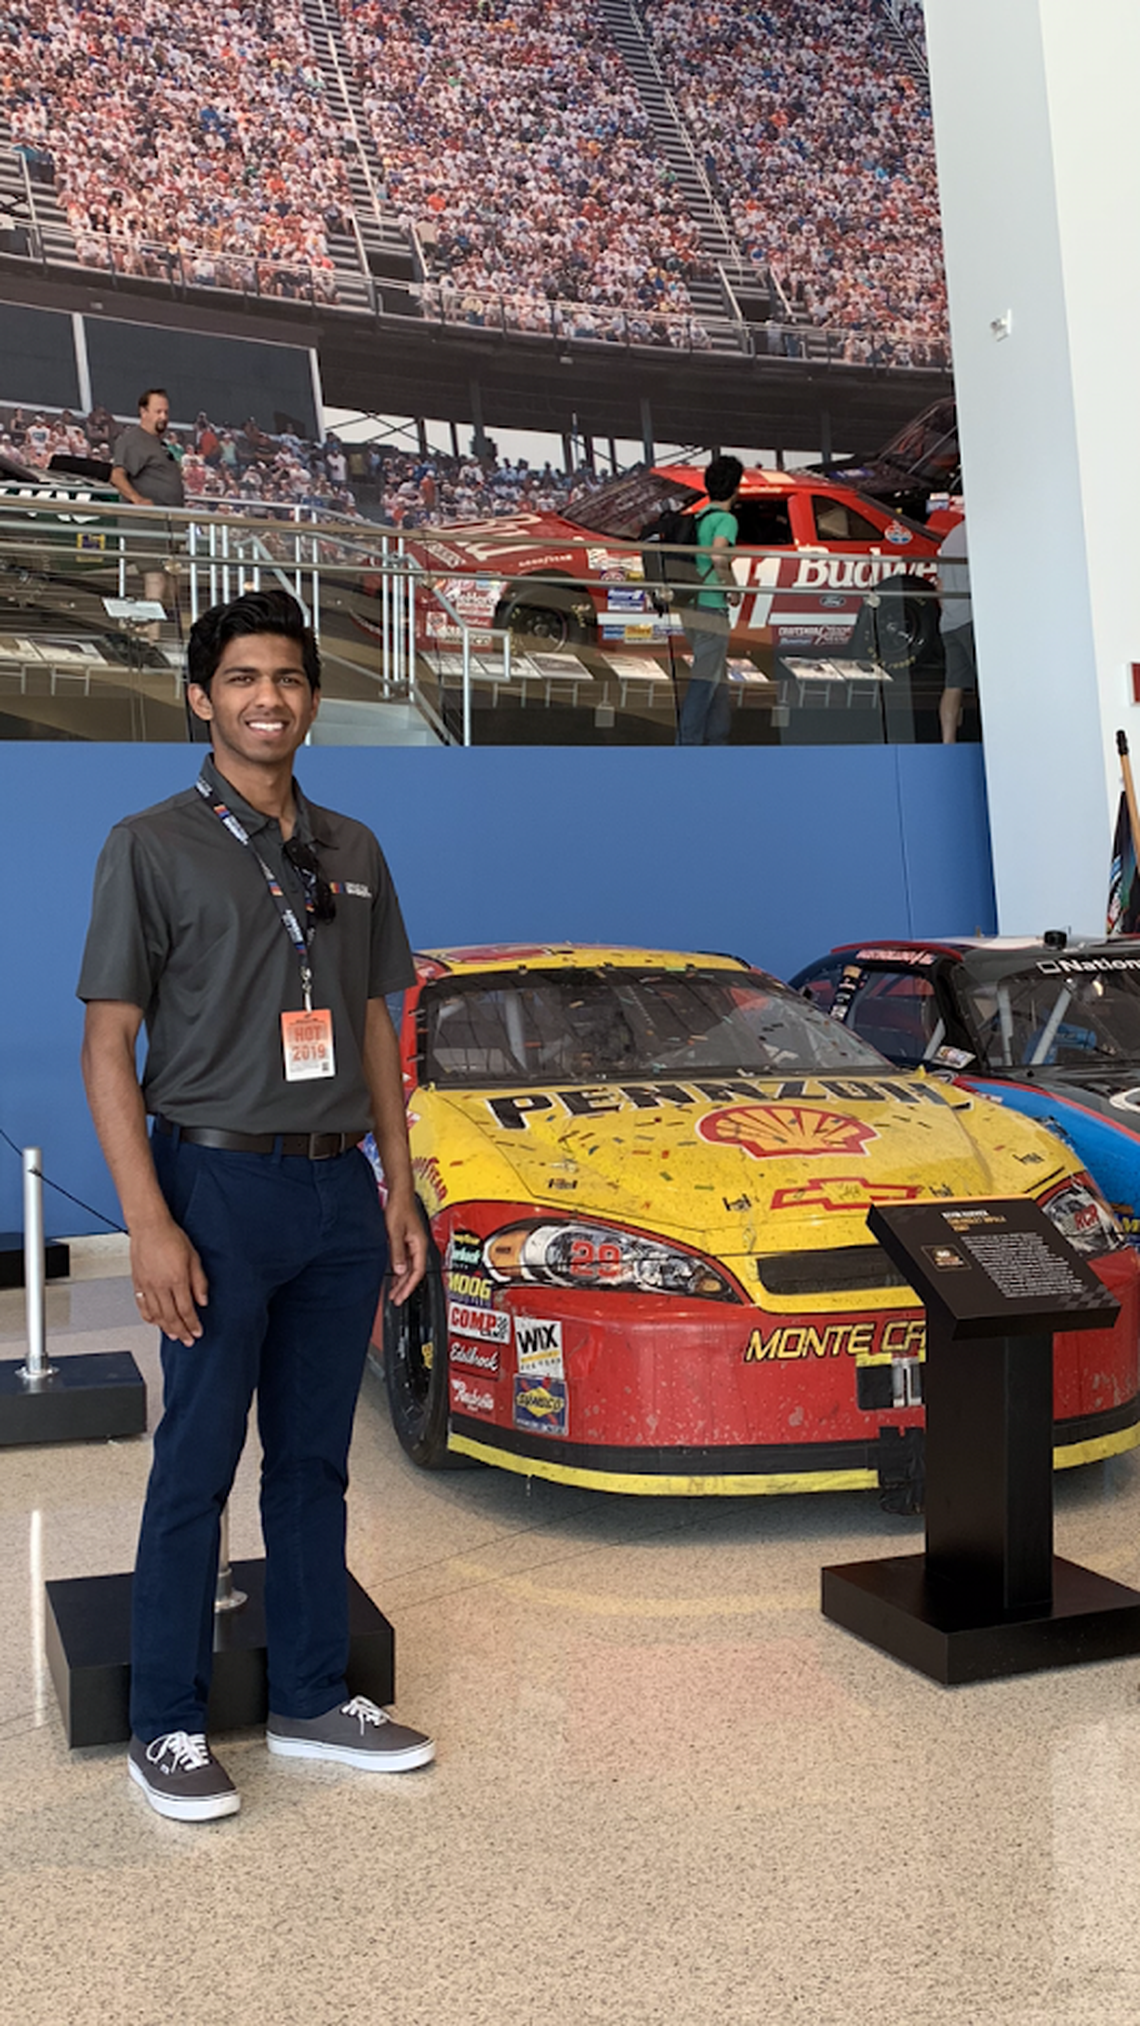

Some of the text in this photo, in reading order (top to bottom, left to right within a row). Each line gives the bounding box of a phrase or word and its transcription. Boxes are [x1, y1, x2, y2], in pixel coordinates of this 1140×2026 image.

[294, 1026, 321, 1042] HOT
[292, 1044, 326, 1061] 2019
[486, 1079, 972, 1131] PENNZOIL
[570, 1240, 620, 1277] 29
[448, 1272, 493, 1300] MOOG
[451, 1307, 497, 1332] COMP
[517, 1323, 559, 1354] WIX
[743, 1322, 876, 1362] MONTE
[517, 1393, 564, 1411] SUNOCO
